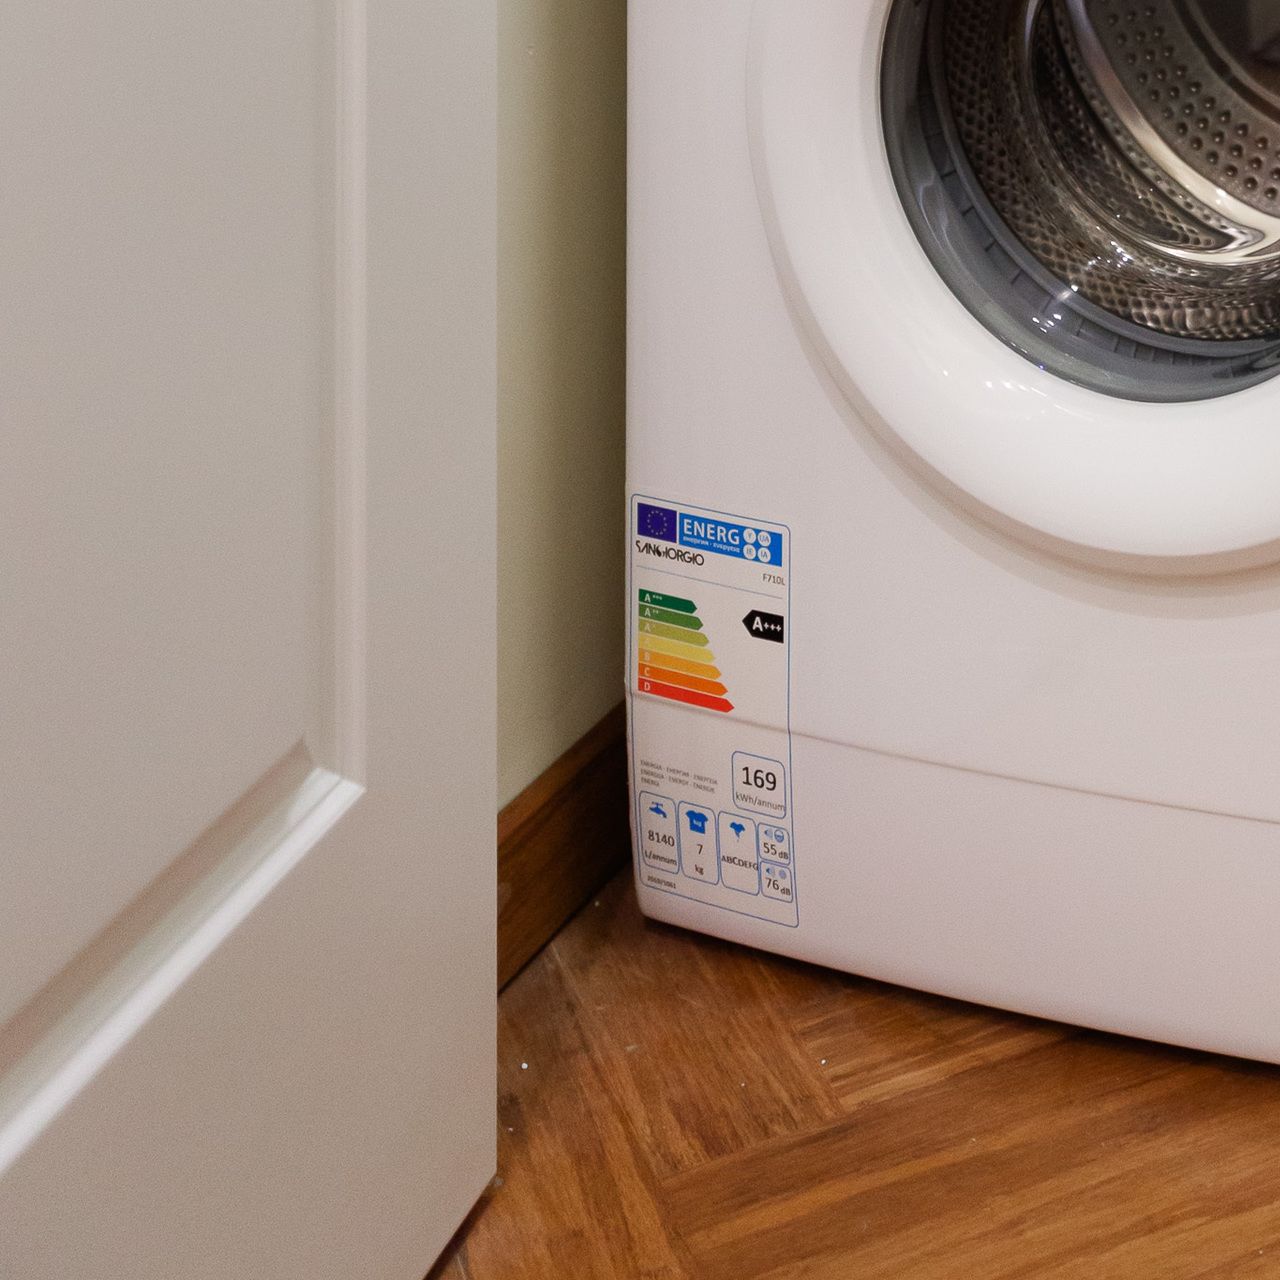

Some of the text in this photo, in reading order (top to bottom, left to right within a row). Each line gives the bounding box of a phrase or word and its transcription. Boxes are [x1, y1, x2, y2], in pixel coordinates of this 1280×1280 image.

[684, 518, 740, 545] ENERG
[741, 766, 777, 791] 169
[735, 792, 785, 812] kWh/annum
[648, 830, 675, 847] 8140
[763, 842, 789, 860] 55 dB
[765, 878, 791, 896] 76 dB
